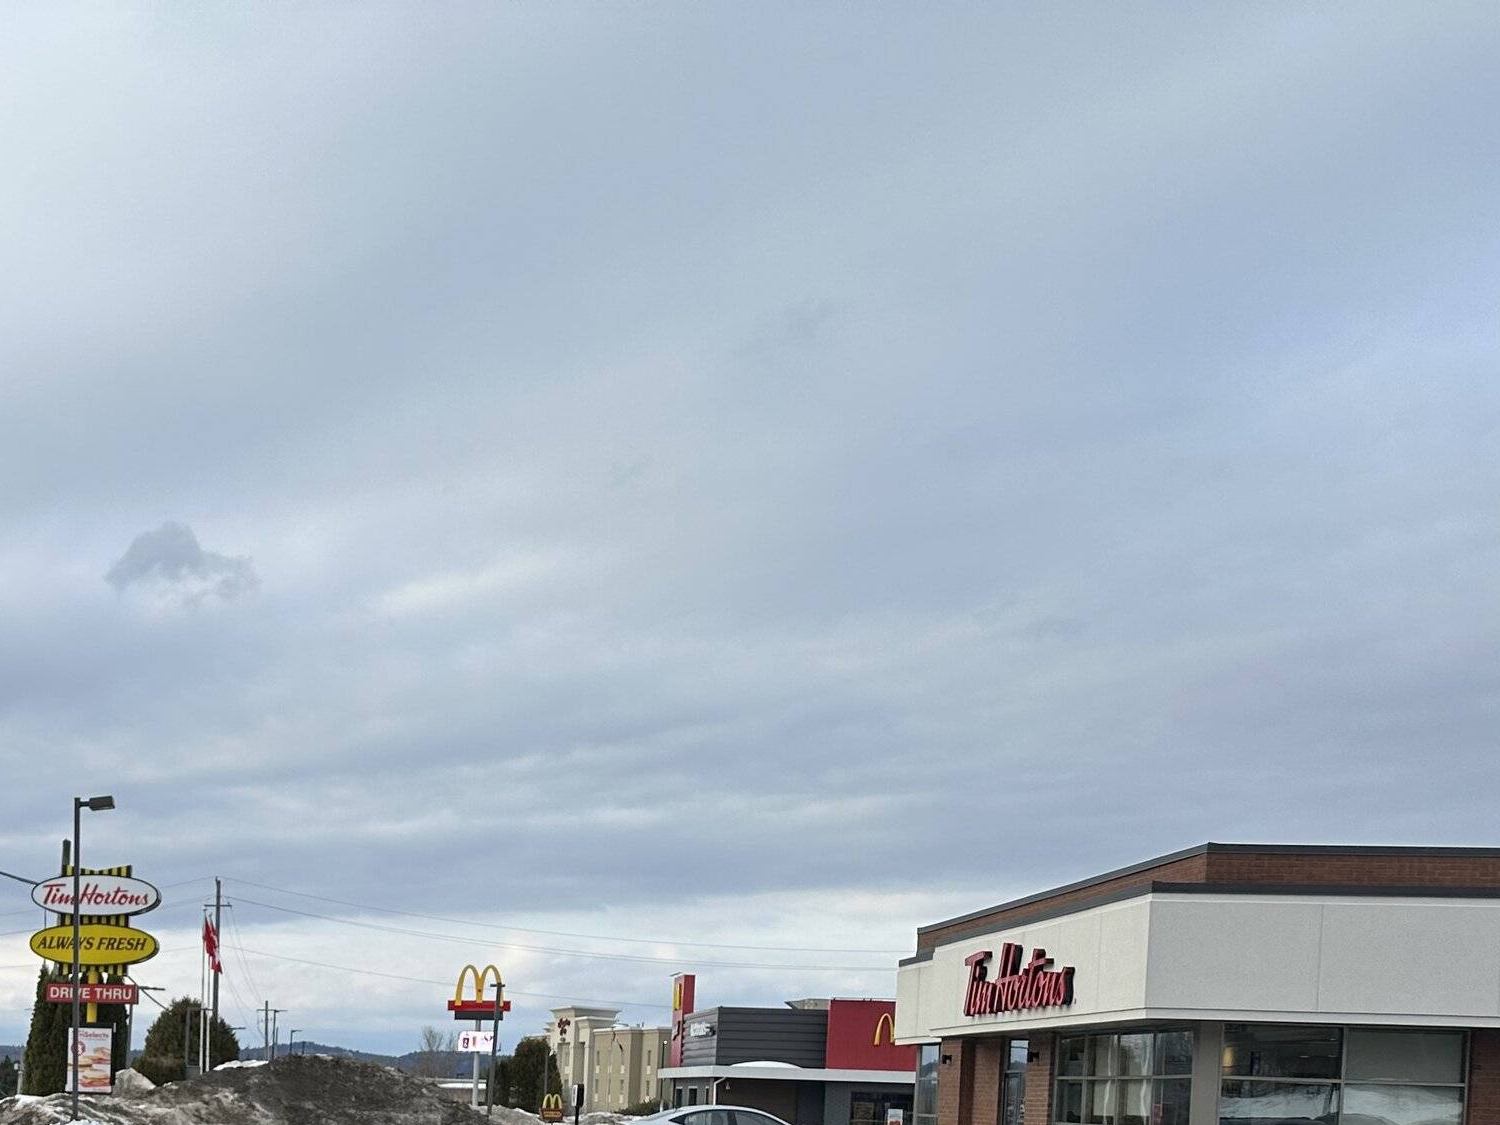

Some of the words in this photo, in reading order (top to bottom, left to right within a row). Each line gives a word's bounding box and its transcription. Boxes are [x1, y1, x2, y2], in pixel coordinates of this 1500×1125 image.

[42, 883, 77, 905] Tim
[79, 882, 148, 905] Hortons
[97, 937, 147, 951] FRESH
[964, 951, 997, 1017] Tim
[994, 942, 1076, 1012] Hortons
[94, 987, 132, 1000] THRU
